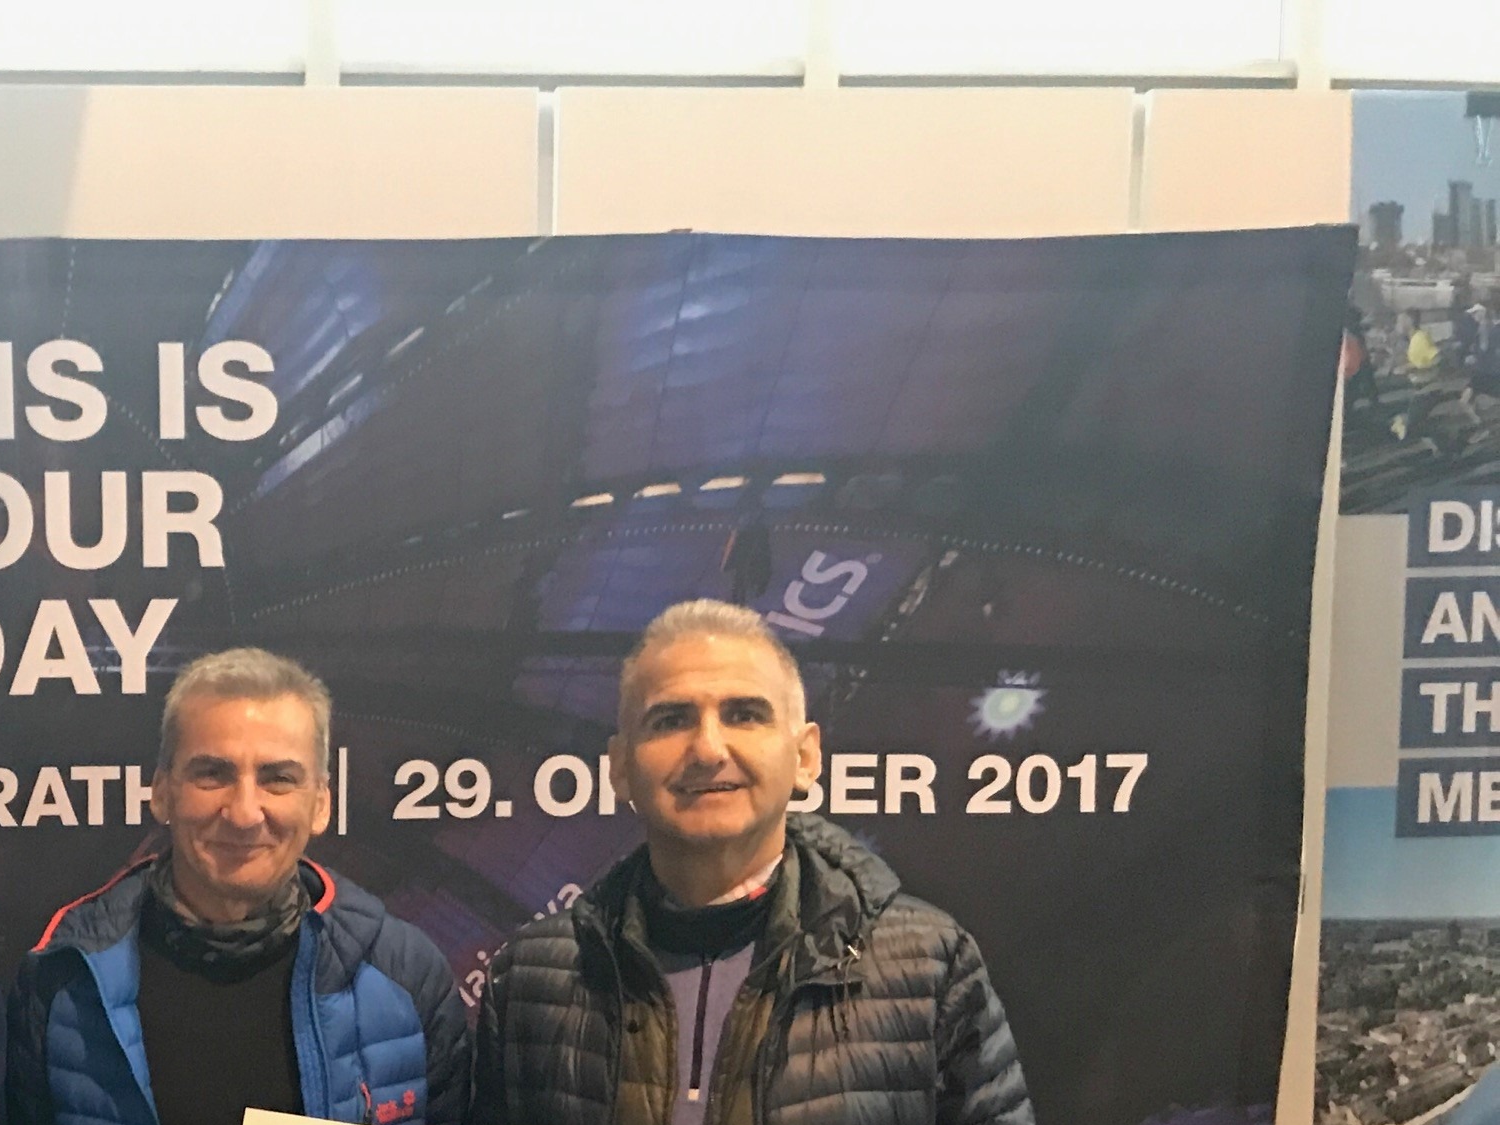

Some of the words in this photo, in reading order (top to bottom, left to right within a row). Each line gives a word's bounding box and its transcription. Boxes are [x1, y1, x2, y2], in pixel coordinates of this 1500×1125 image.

[158, 341, 279, 442] IS
[1428, 500, 1500, 552] DI
[392, 758, 512, 820] 29.
[965, 753, 1149, 814] 2017
